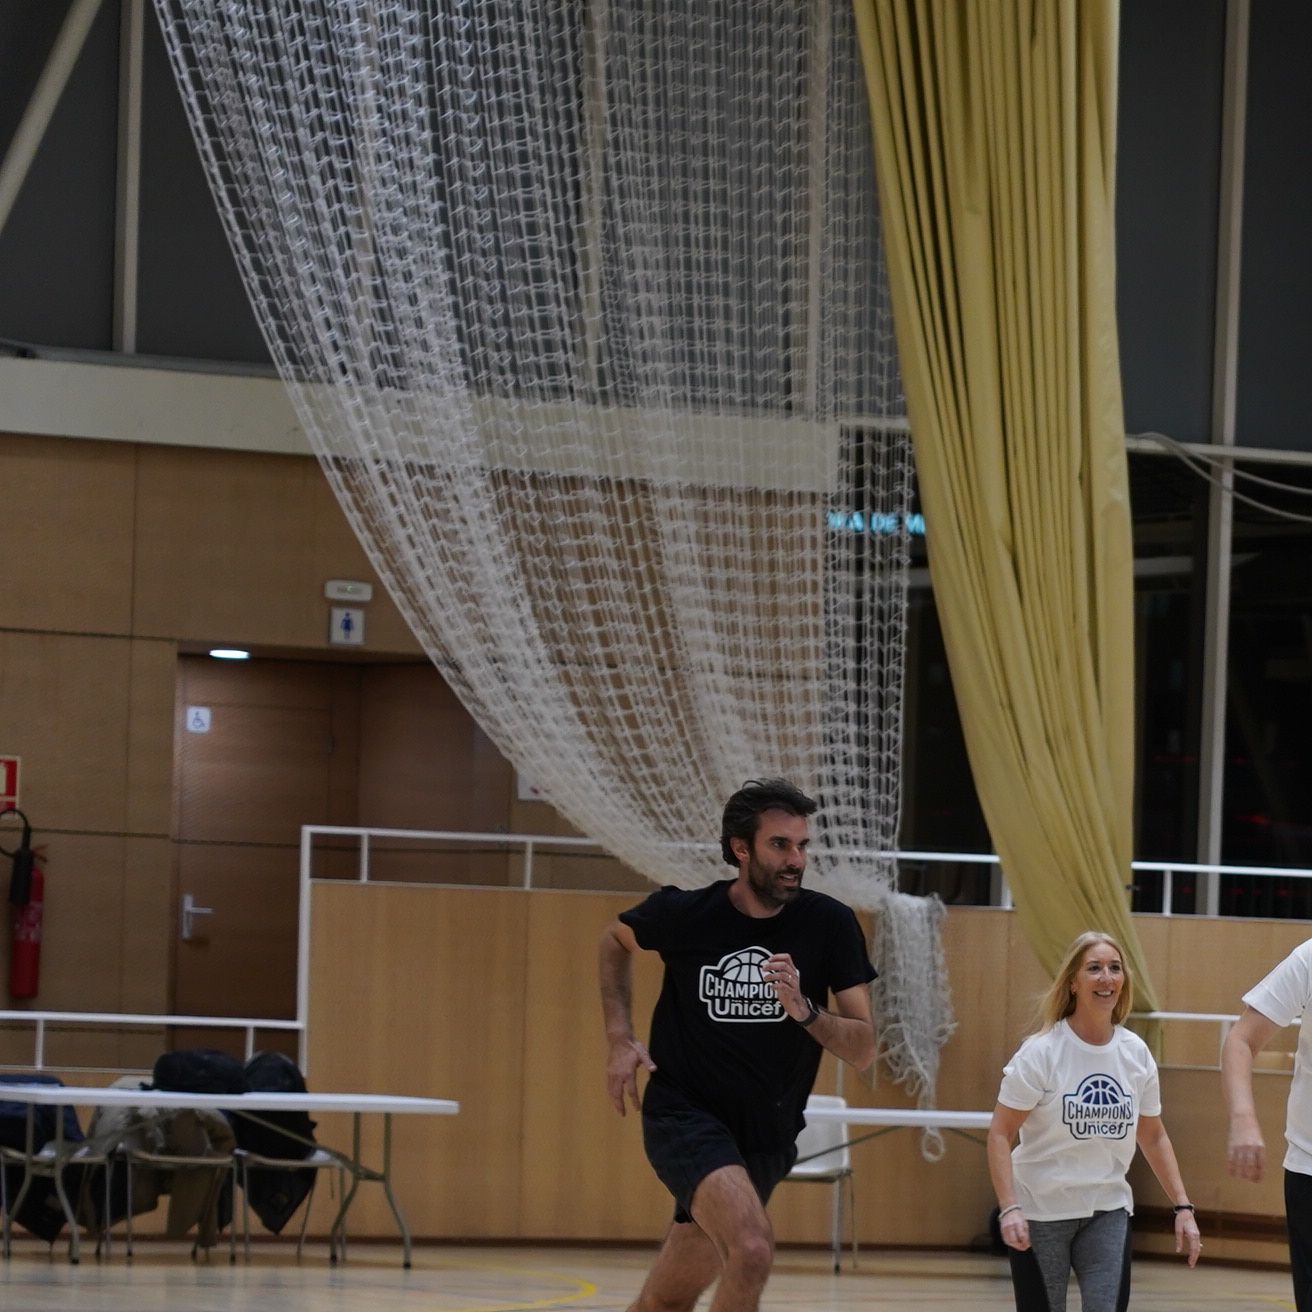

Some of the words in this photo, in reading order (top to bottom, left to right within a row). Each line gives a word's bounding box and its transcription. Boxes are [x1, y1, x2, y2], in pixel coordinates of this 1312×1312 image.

[705, 973, 779, 999] CHAMPIO
[715, 998, 782, 1016] Unicef
[1068, 1101, 1132, 1120] CHAMPIONS
[1076, 1122, 1124, 1135] Unicef
